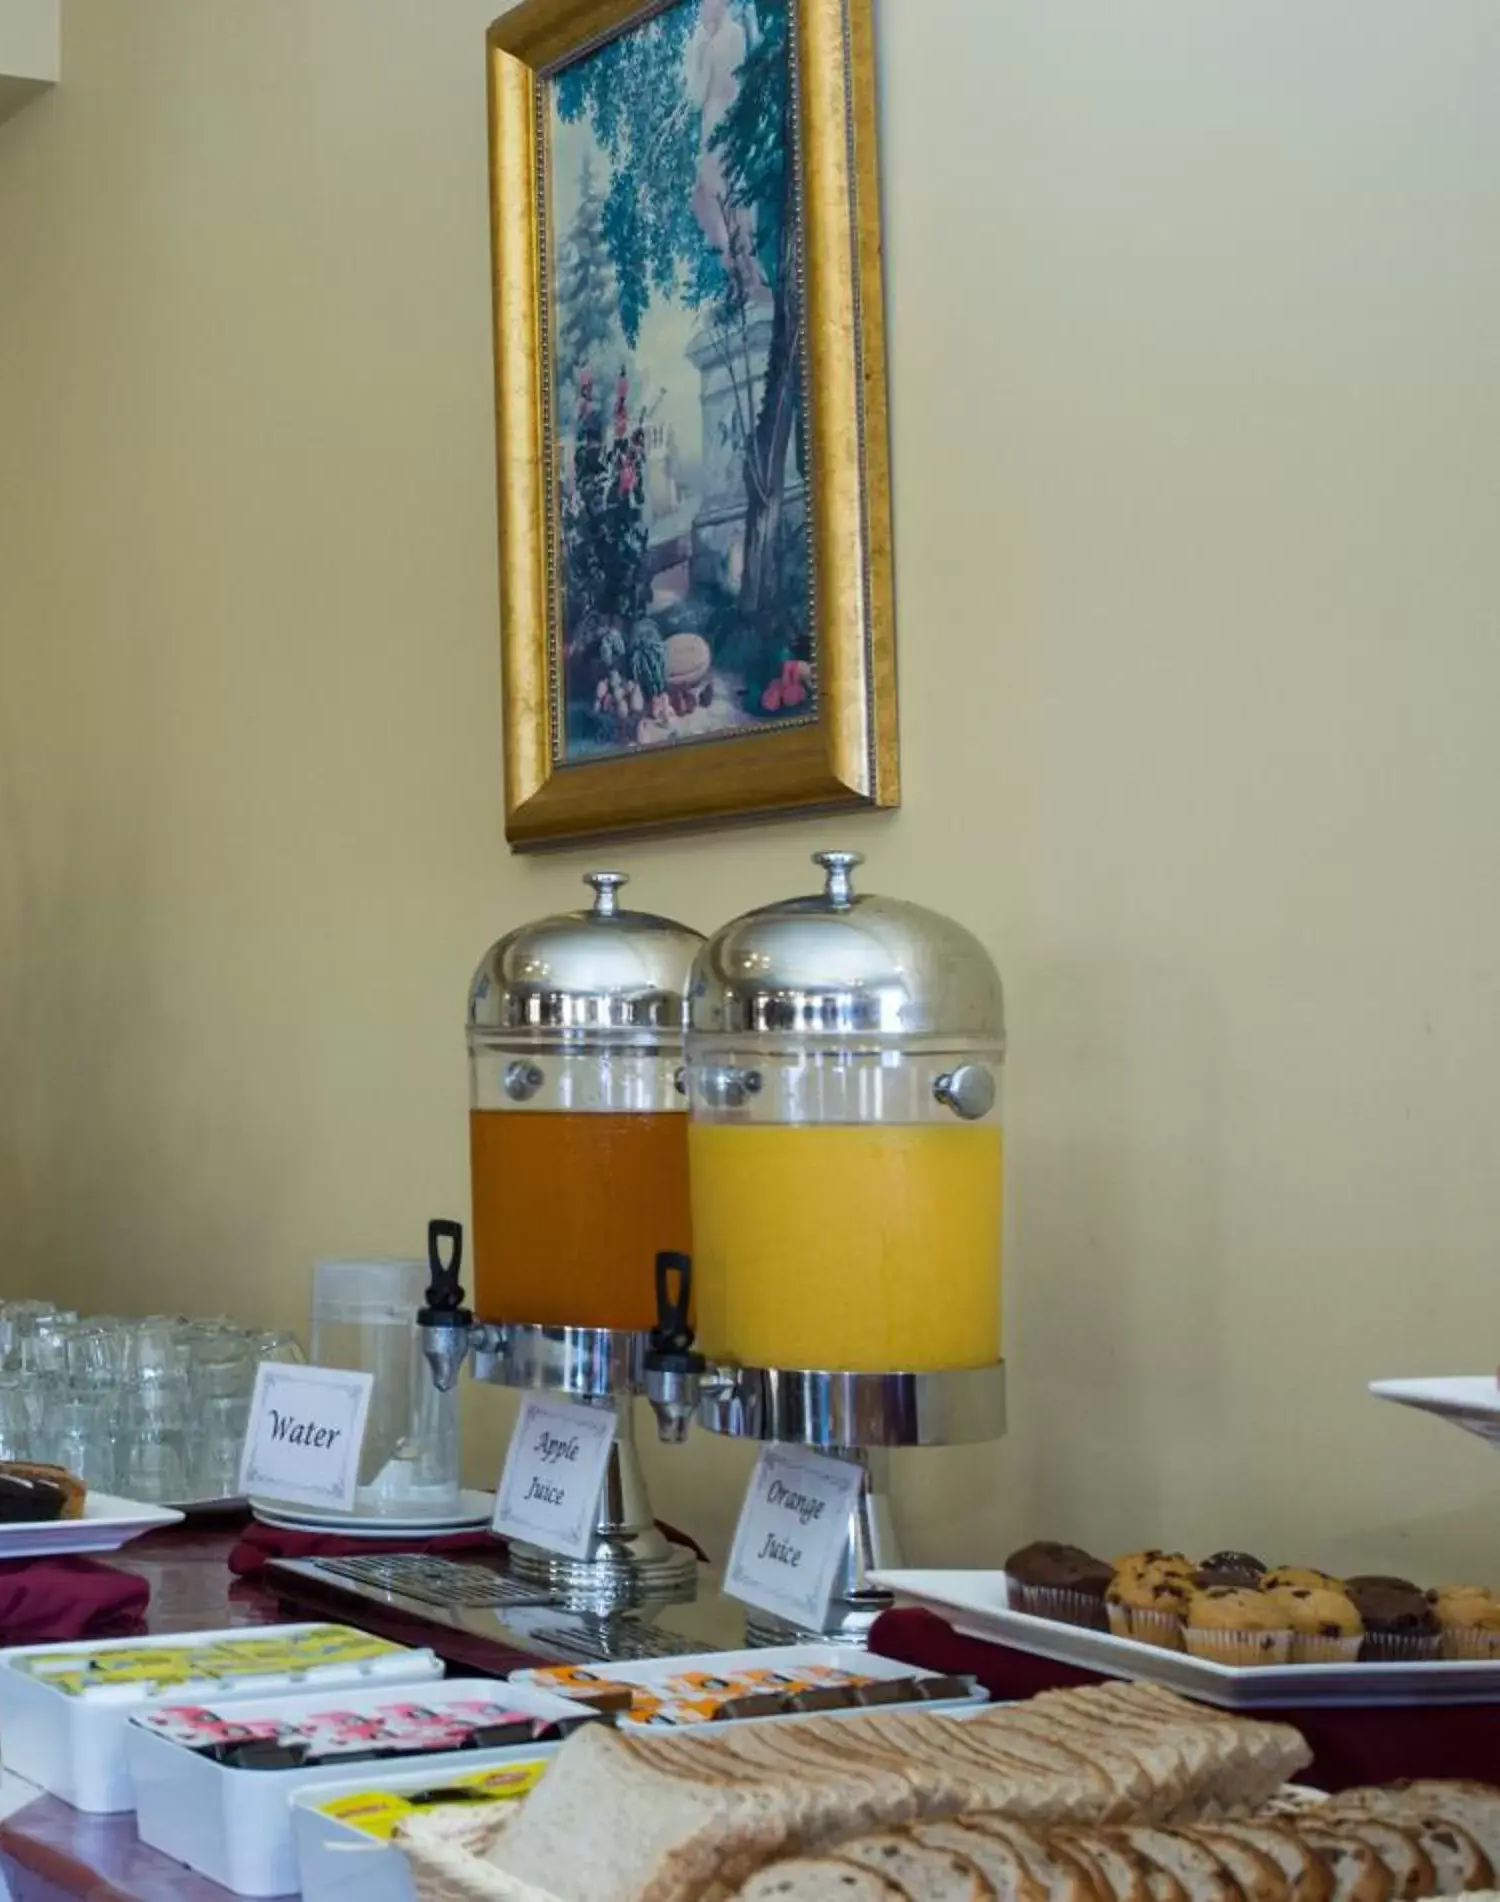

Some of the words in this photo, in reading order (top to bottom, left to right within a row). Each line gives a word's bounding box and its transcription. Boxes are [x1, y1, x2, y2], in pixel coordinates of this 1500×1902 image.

[269, 1410, 341, 1450] Water
[533, 1431, 580, 1464] Apple
[524, 1476, 565, 1505] Juice
[767, 1479, 826, 1525] Orange
[757, 1532, 802, 1568] Juice
